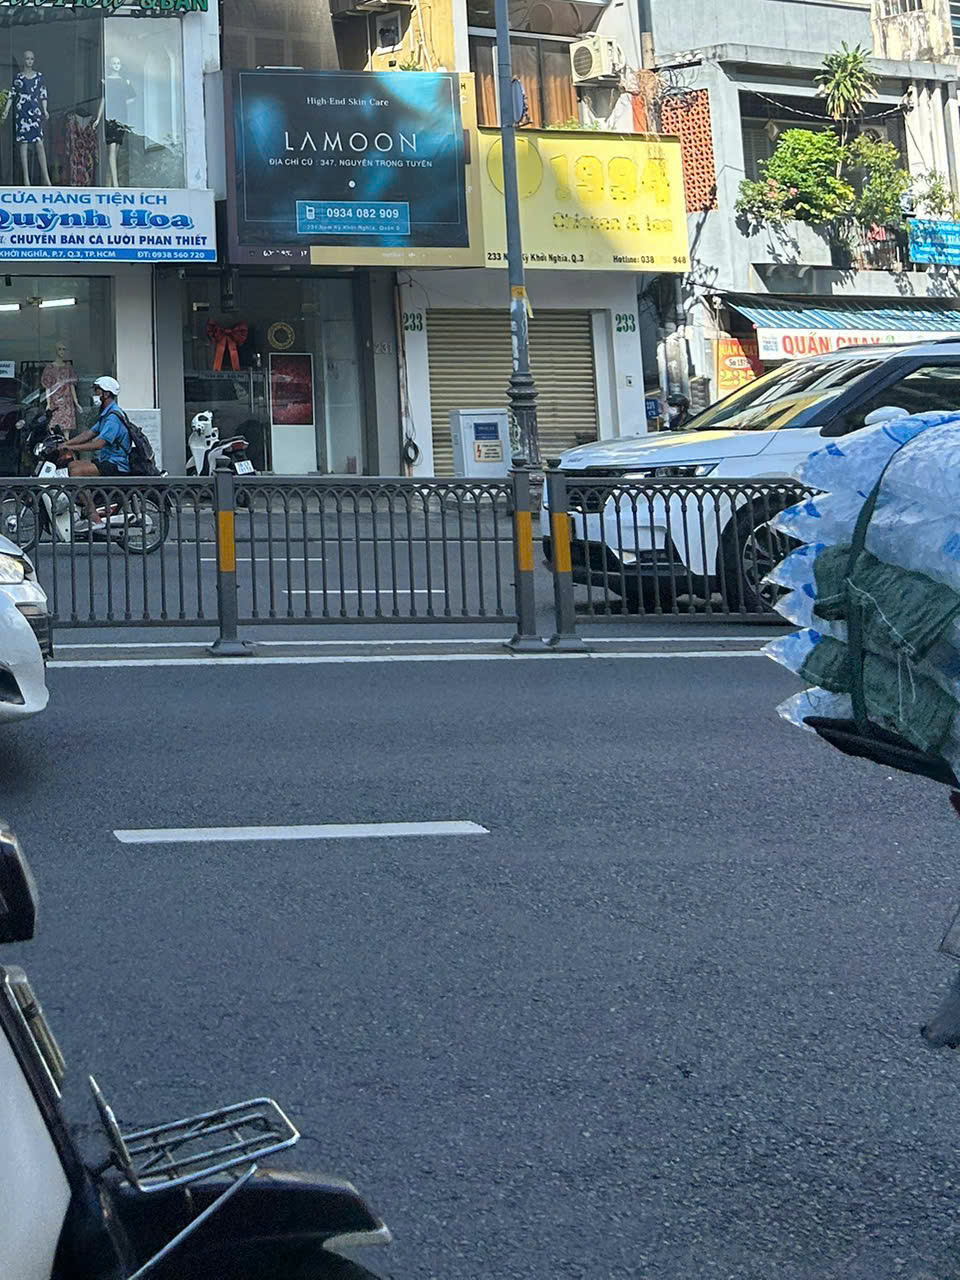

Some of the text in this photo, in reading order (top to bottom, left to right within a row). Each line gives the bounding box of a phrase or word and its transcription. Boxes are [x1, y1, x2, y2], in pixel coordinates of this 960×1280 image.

[306, 96, 389, 107] High-End Skin Care
[285, 131, 417, 152] LAMOON
[1, 190, 167, 207] CỬA HÀNG TIỆN ÍCH
[119, 209, 195, 230] Hoa
[326, 208, 400, 219] 0934 082 909
[9, 232, 57, 245] CHUYÊN
[60, 232, 85, 245] BÁN
[139, 235, 172, 245] PHAN
[175, 232, 207, 245] THIẾT
[0, 249, 20, 257] KHỞI
[21, 249, 50, 258] NGHĨA,
[152, 251, 172, 259] 0938
[487, 252, 502, 261] 233
[530, 252, 547, 262] Khởi
[613, 255, 639, 264] Hotline:
[640, 256, 655, 264] 038
[672, 256, 687, 264] 948
[402, 312, 423, 332] 233
[615, 313, 636, 333] 233
[782, 332, 829, 355] QUÁN
